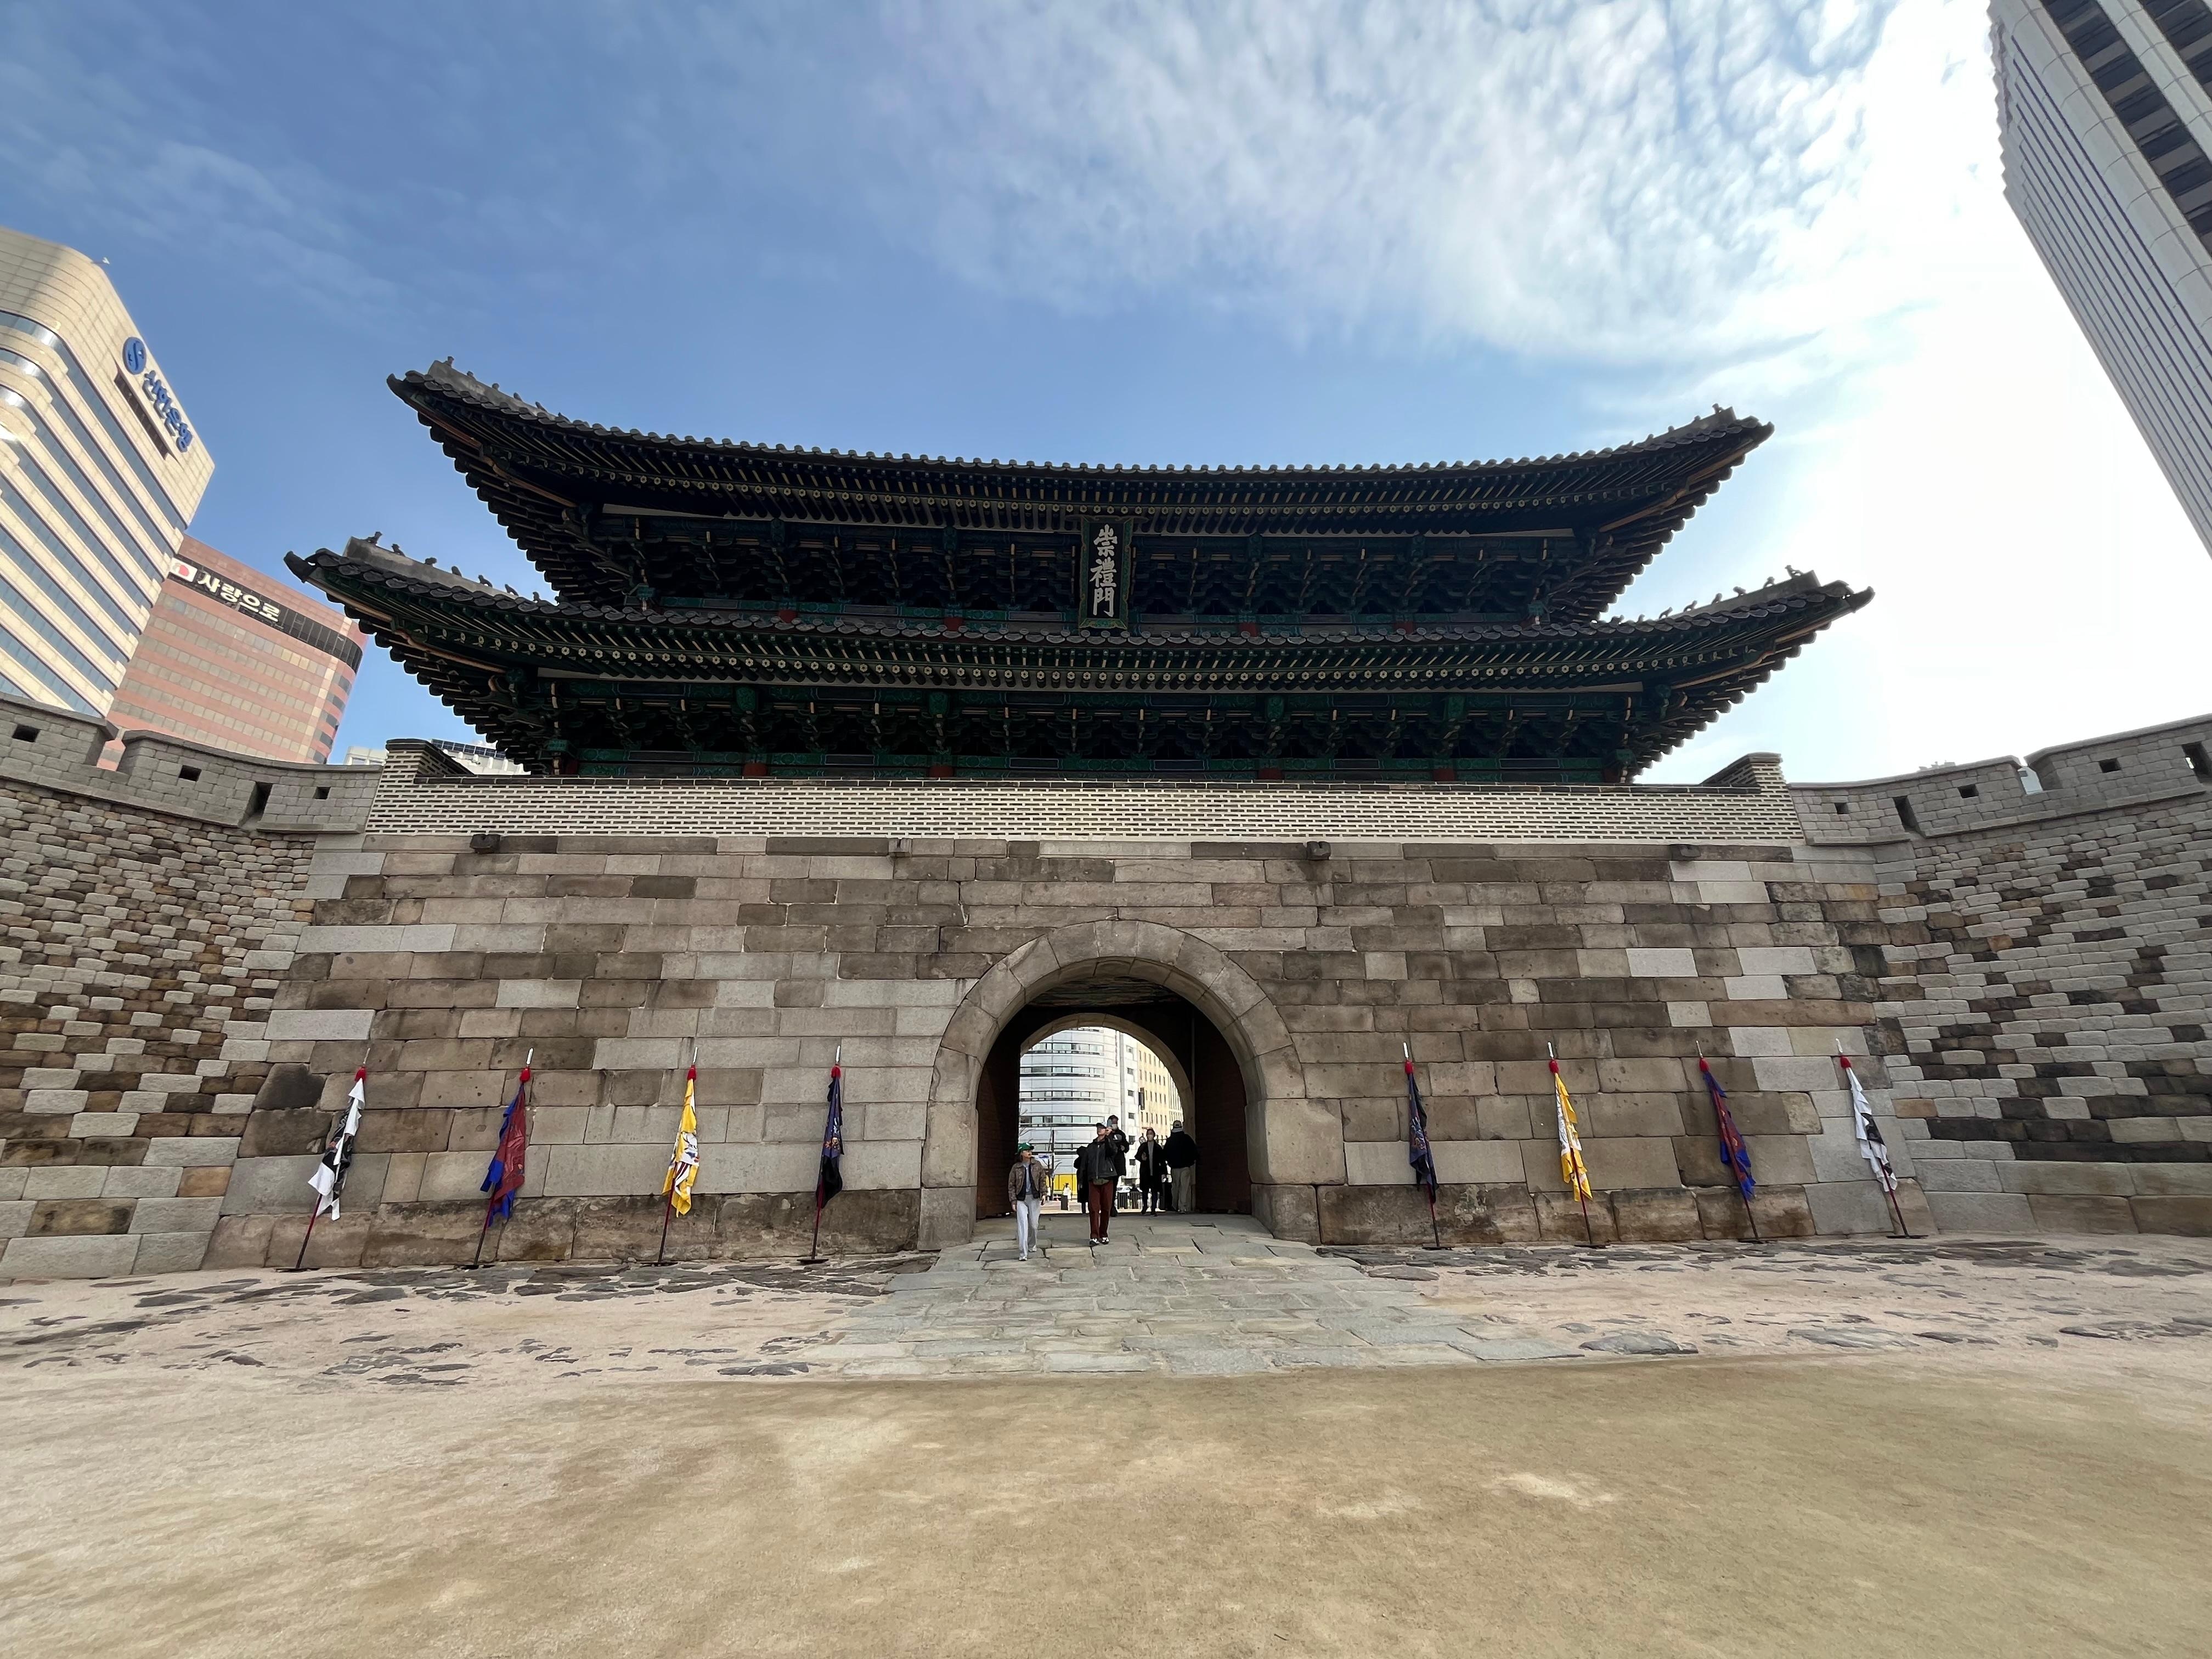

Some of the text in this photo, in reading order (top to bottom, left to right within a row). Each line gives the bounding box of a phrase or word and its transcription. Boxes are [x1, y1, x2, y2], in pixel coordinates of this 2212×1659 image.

[142, 370, 193, 453] 신한은행
[198, 572, 281, 623] 사랑으로
[1090, 524, 1118, 617] 崇禮門
